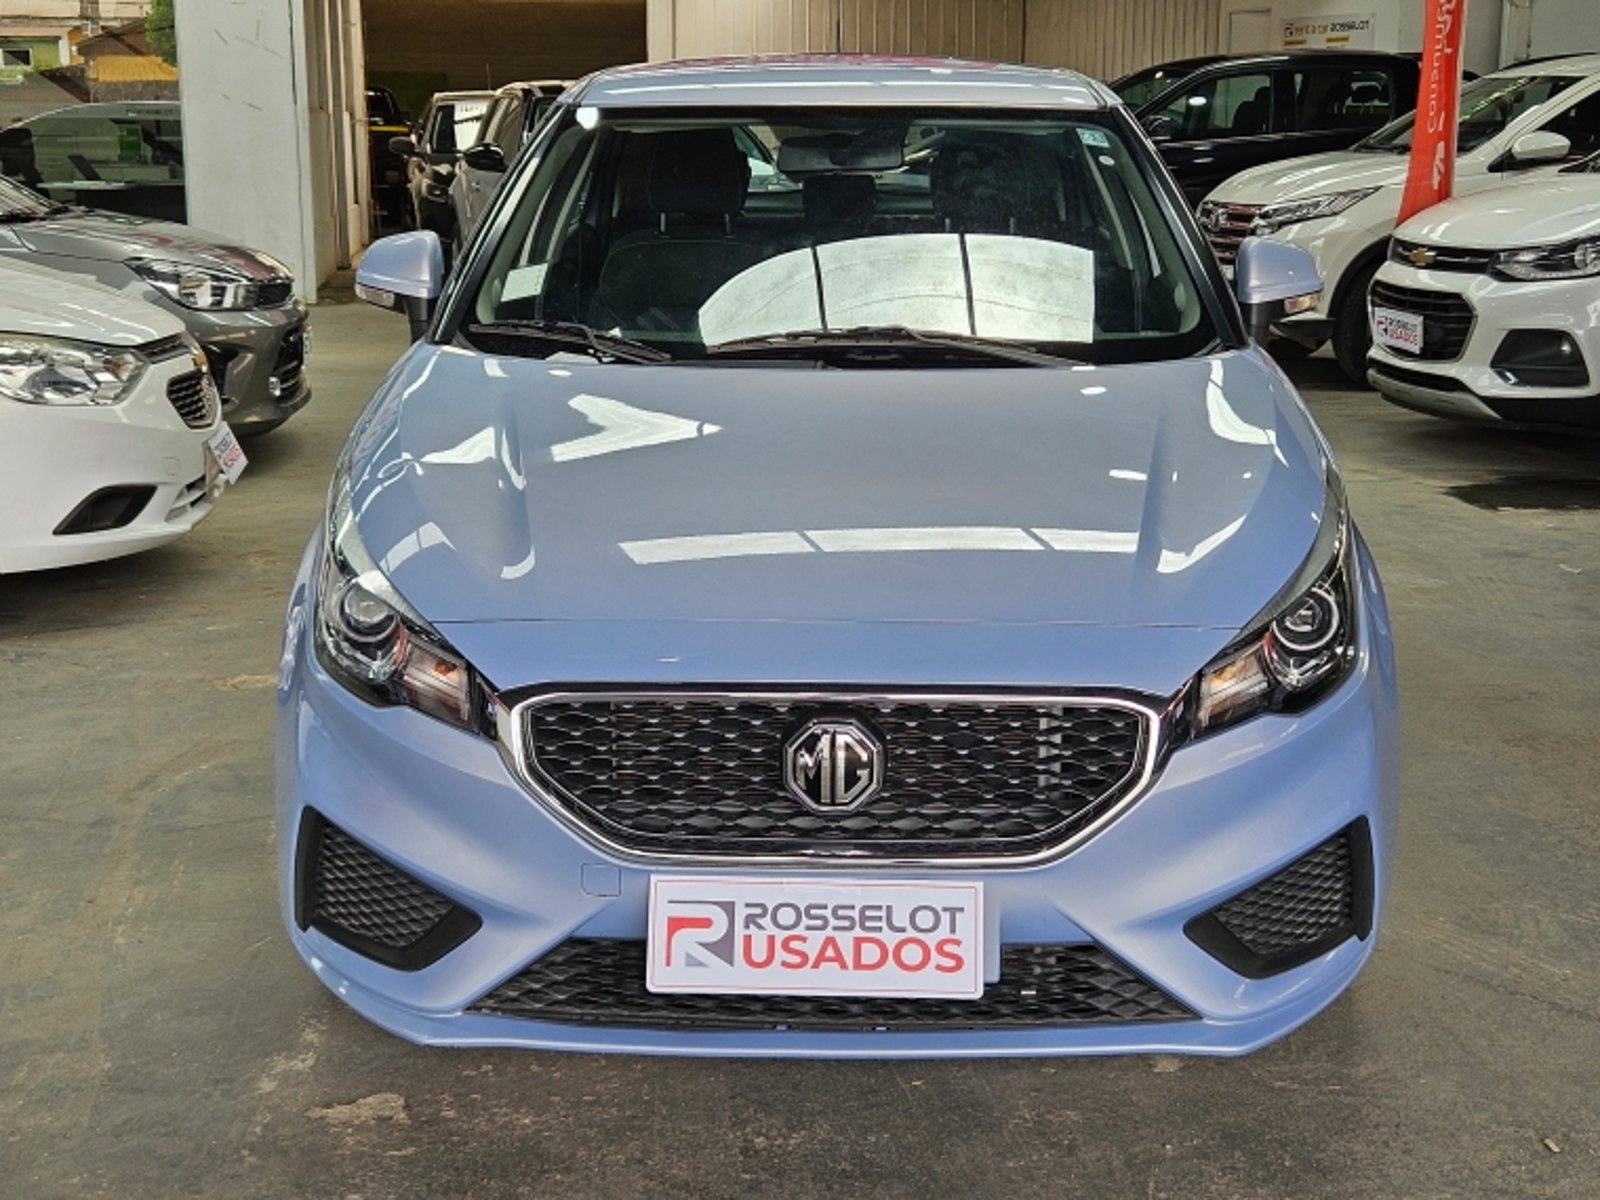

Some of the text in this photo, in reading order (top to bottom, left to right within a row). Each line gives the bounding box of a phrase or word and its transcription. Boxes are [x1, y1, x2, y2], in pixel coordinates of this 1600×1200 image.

[795, 732, 871, 804] MG
[743, 902, 965, 934] ROSSELOT
[742, 934, 965, 973] USADOS
